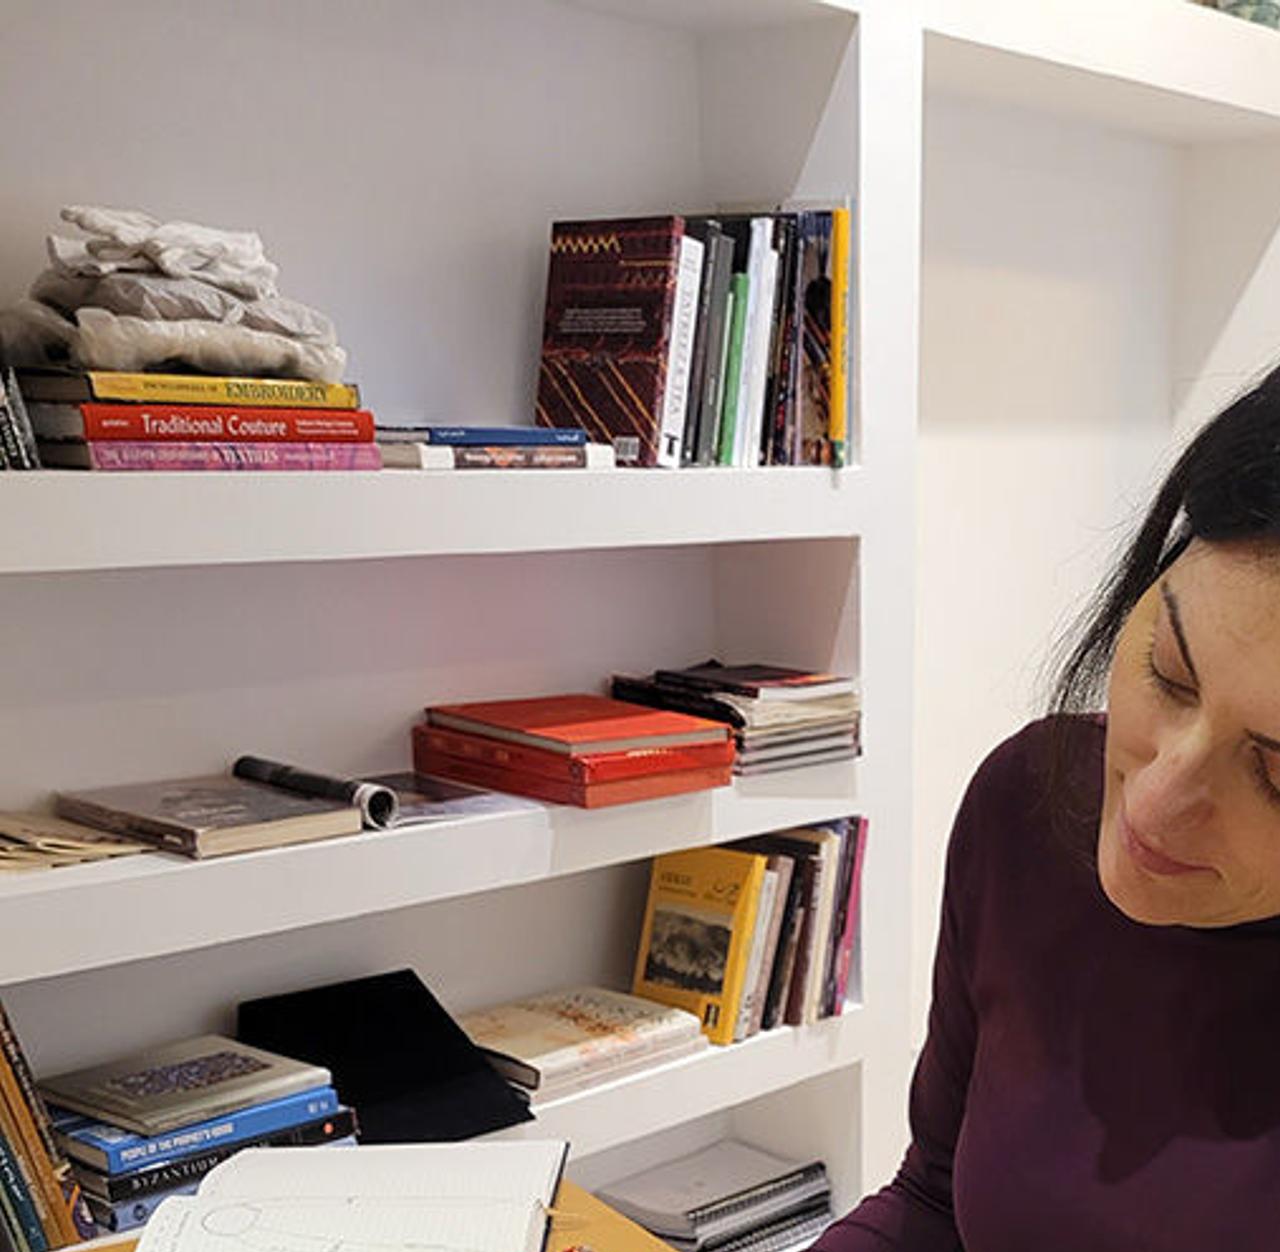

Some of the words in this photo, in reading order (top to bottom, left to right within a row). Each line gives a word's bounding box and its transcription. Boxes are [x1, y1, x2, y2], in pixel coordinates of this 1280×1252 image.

[140, 413, 223, 435] Traditional
[226, 414, 287, 436] Couture
[131, 1156, 219, 1190] BYZANTIUM
